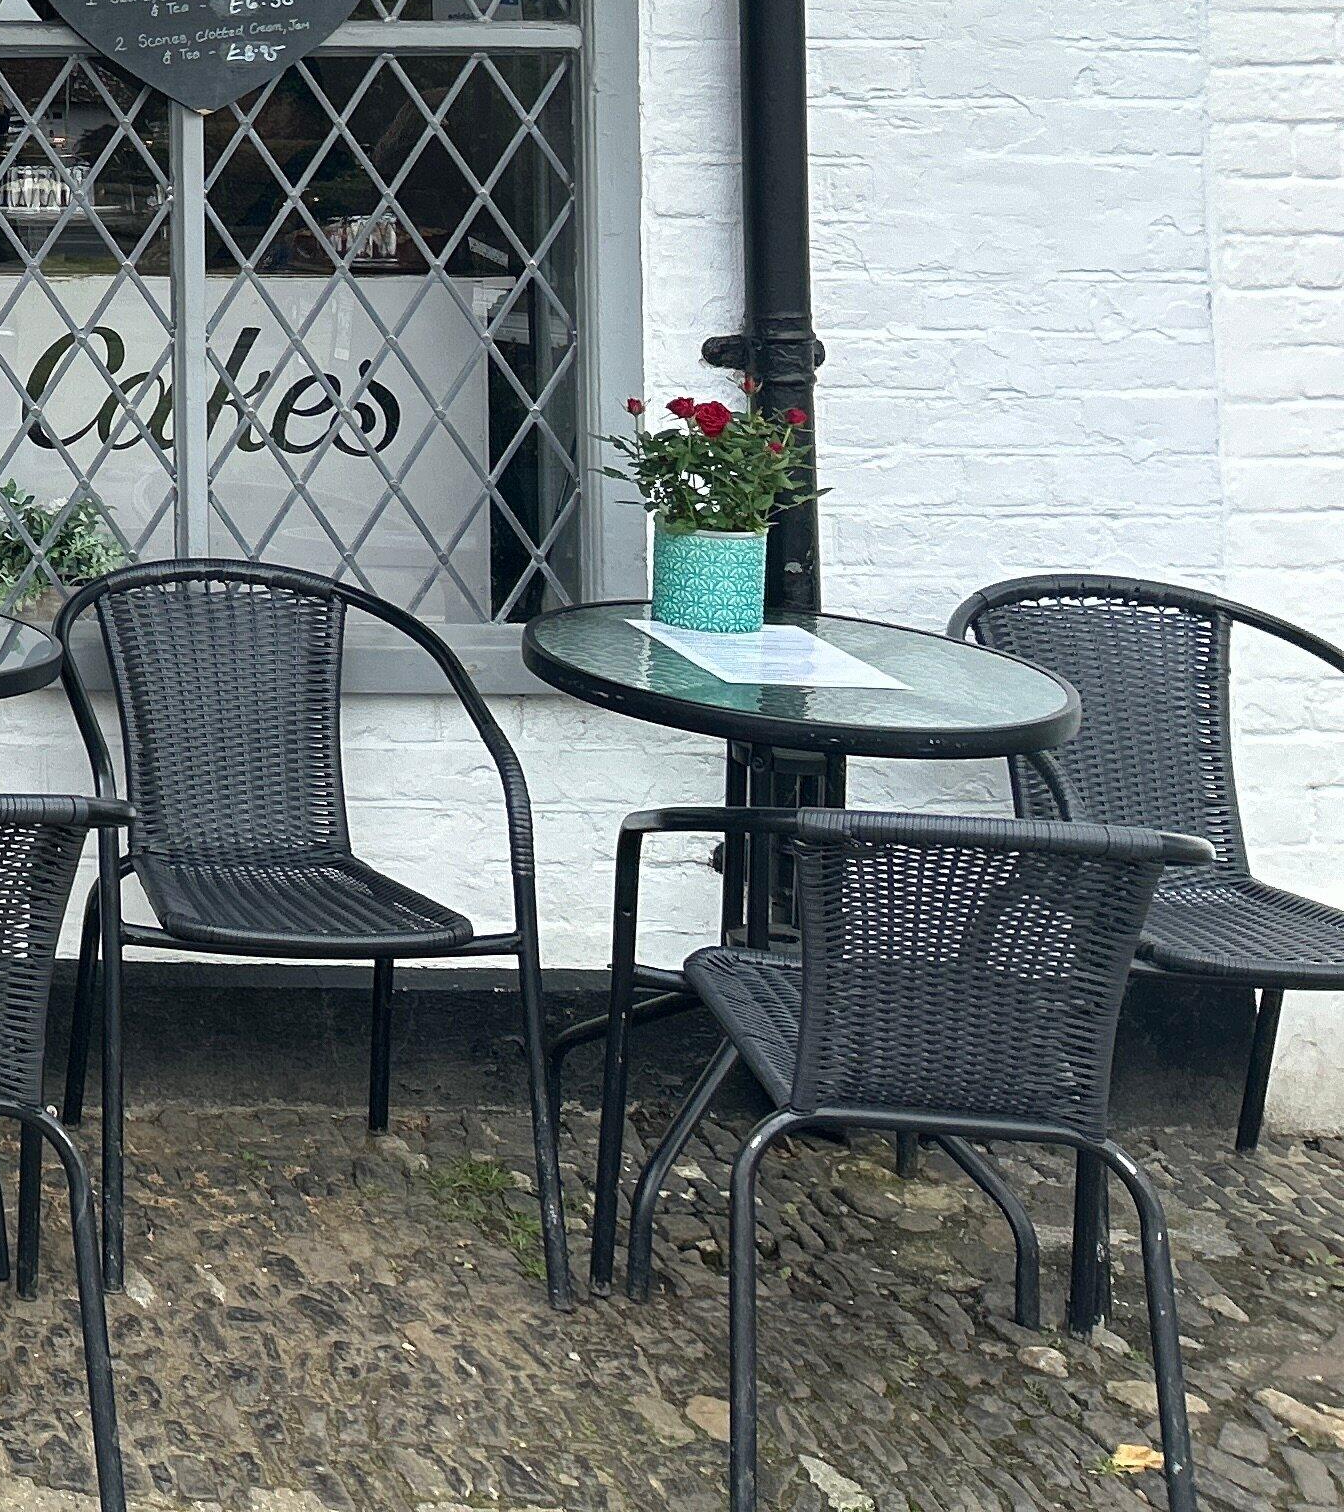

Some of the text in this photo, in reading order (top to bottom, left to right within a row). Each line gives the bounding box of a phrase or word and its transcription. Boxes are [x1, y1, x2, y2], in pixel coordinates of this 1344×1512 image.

[165, 2, 190, 15] Tea
[114, 37, 128, 52] 2
[288, 19, 310, 30] Jam
[180, 48, 200, 60] Tea
[22, 326, 402, 457] Cakes
